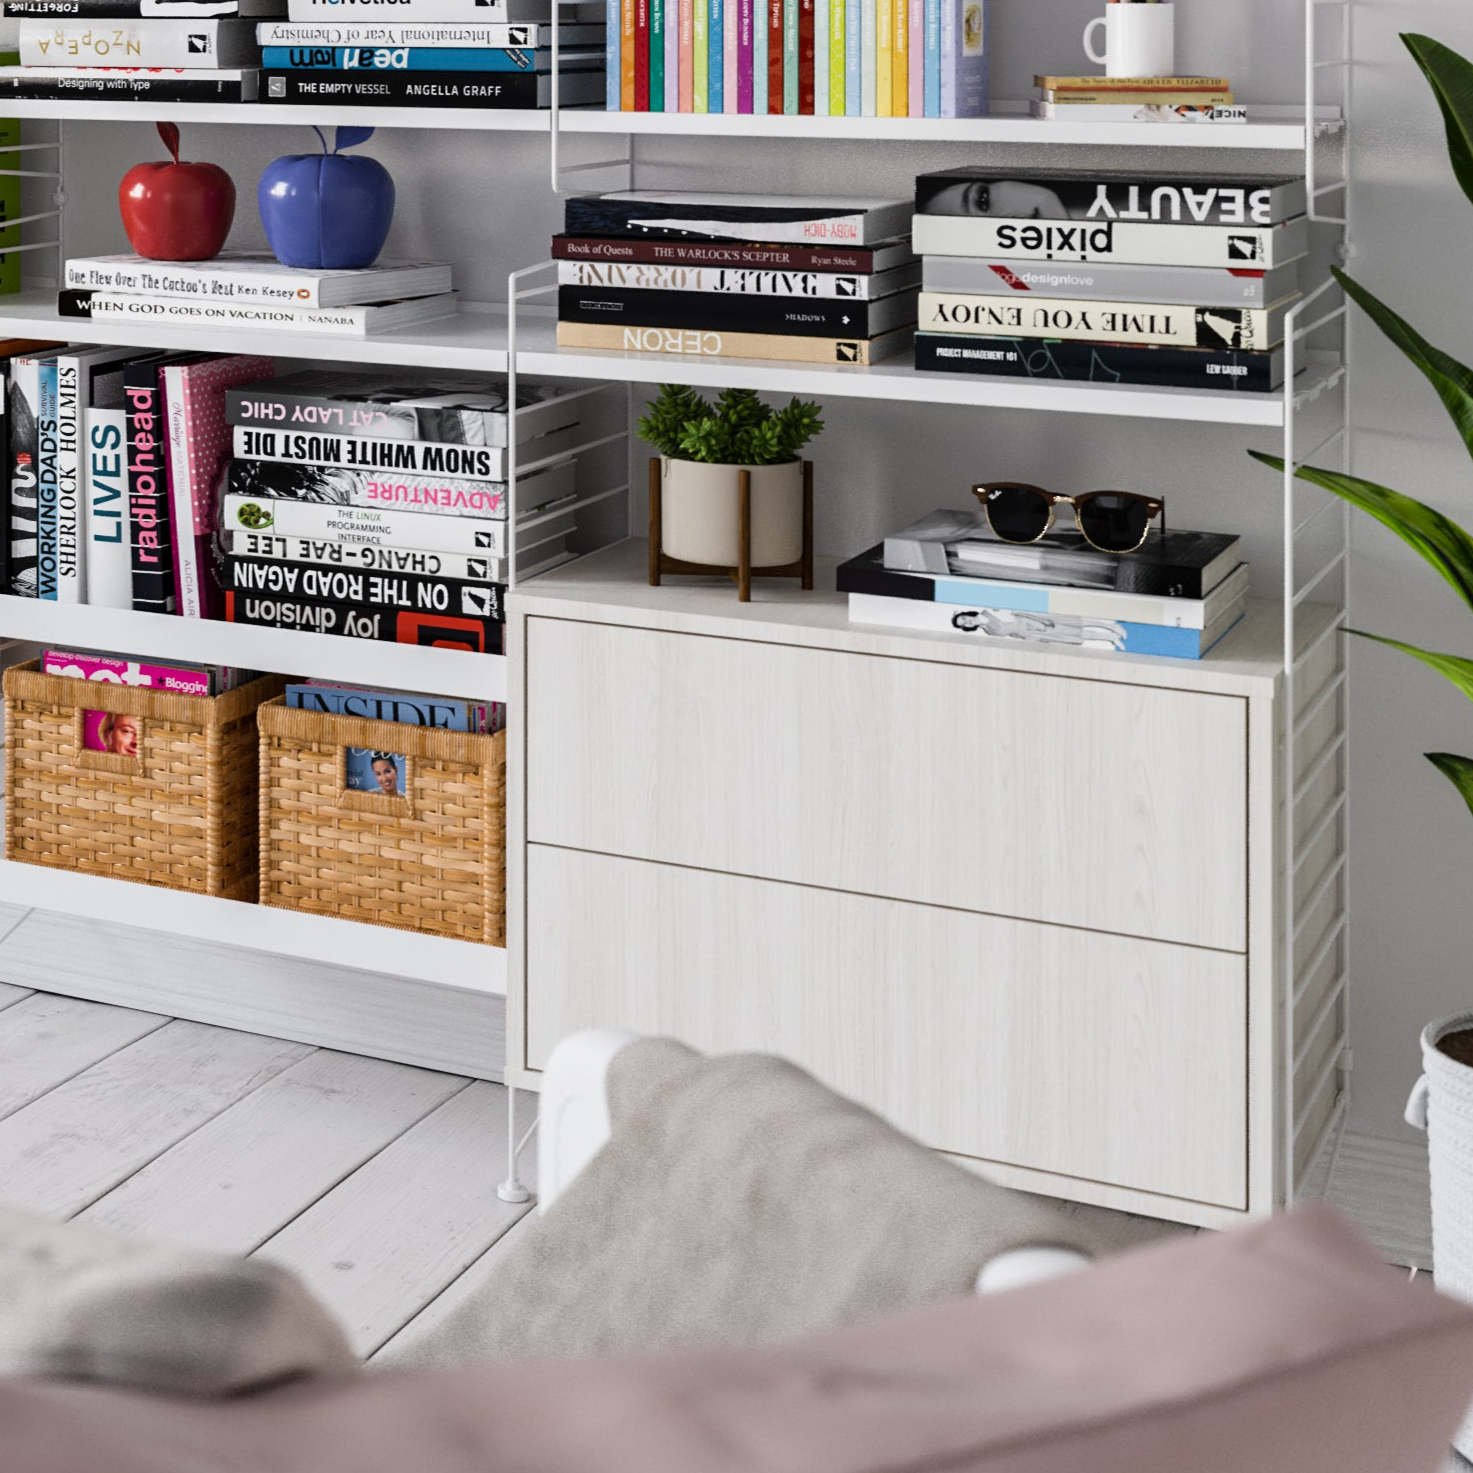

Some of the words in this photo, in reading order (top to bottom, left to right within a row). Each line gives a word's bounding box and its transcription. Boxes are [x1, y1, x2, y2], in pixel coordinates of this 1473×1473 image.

[8, 3, 78, 12] FORGETTING
[271, 26, 342, 43] Chemistry
[344, 30, 360, 43] of
[365, 30, 394, 44] Year
[402, 33, 490, 44] International
[290, 48, 336, 67] jam
[344, 48, 410, 69] pearl
[58, 78, 104, 90] Designing
[107, 79, 127, 89] with
[129, 79, 152, 91] Type
[298, 83, 317, 93] THE
[319, 84, 353, 94] EMPTY
[355, 84, 391, 94] VESSEL
[406, 85, 459, 96] ANGELLA
[464, 86, 502, 96] GRAFF
[1086, 185, 1271, 223] BEAUTY
[996, 221, 1114, 260] pixies
[567, 243, 591, 254] Book
[593, 244, 602, 255] of
[604, 244, 633, 257] Quests
[653, 247, 675, 258] THE
[742, 250, 790, 263] SCEPTER
[811, 255, 831, 267] Ryan
[833, 256, 857, 267] Steele
[69, 268, 86, 285] One
[90, 270, 112, 287] Flew
[115, 272, 138, 289] Over
[142, 273, 160, 290] The
[211, 277, 234, 296] Nest
[238, 285, 258, 296] Ken
[262, 286, 295, 301] Kesey
[573, 263, 703, 290] LORRAINE
[713, 269, 817, 296] BALLET
[76, 298, 125, 313] WHEN
[128, 302, 165, 315] GOD
[169, 305, 202, 318] GOES
[206, 307, 226, 319] ON
[229, 309, 294, 322] VACATION
[308, 315, 355, 326] NANABA
[932, 303, 1023, 326] ENJOY
[1033, 308, 1097, 331] YOU
[1101, 312, 1177, 335] TIME
[624, 328, 722, 355] CERON
[60, 366, 77, 454] HOLMES
[241, 400, 287, 420] CHIC
[291, 404, 344, 425] LADY
[350, 409, 388, 428] CAT
[243, 431, 276, 455] DIE
[280, 434, 341, 463] MUST
[347, 439, 417, 470] WHITE
[422, 446, 491, 476] SNOW
[92, 424, 123, 544] LIVES
[126, 387, 159, 563] radiohead
[367, 482, 501, 511] ADVENTURE
[59, 466, 77, 577] SHERLOCK
[327, 520, 391, 535] PROGRAMMING
[337, 510, 355, 519] THE
[356, 511, 382, 522] LINUX
[337, 533, 382, 545] INTERFACE
[233, 561, 299, 592] AGAIN
[303, 568, 364, 600] ROAD
[370, 576, 411, 605] THE
[418, 581, 449, 611] ON
[245, 598, 336, 634] division
[343, 611, 381, 640] joy
